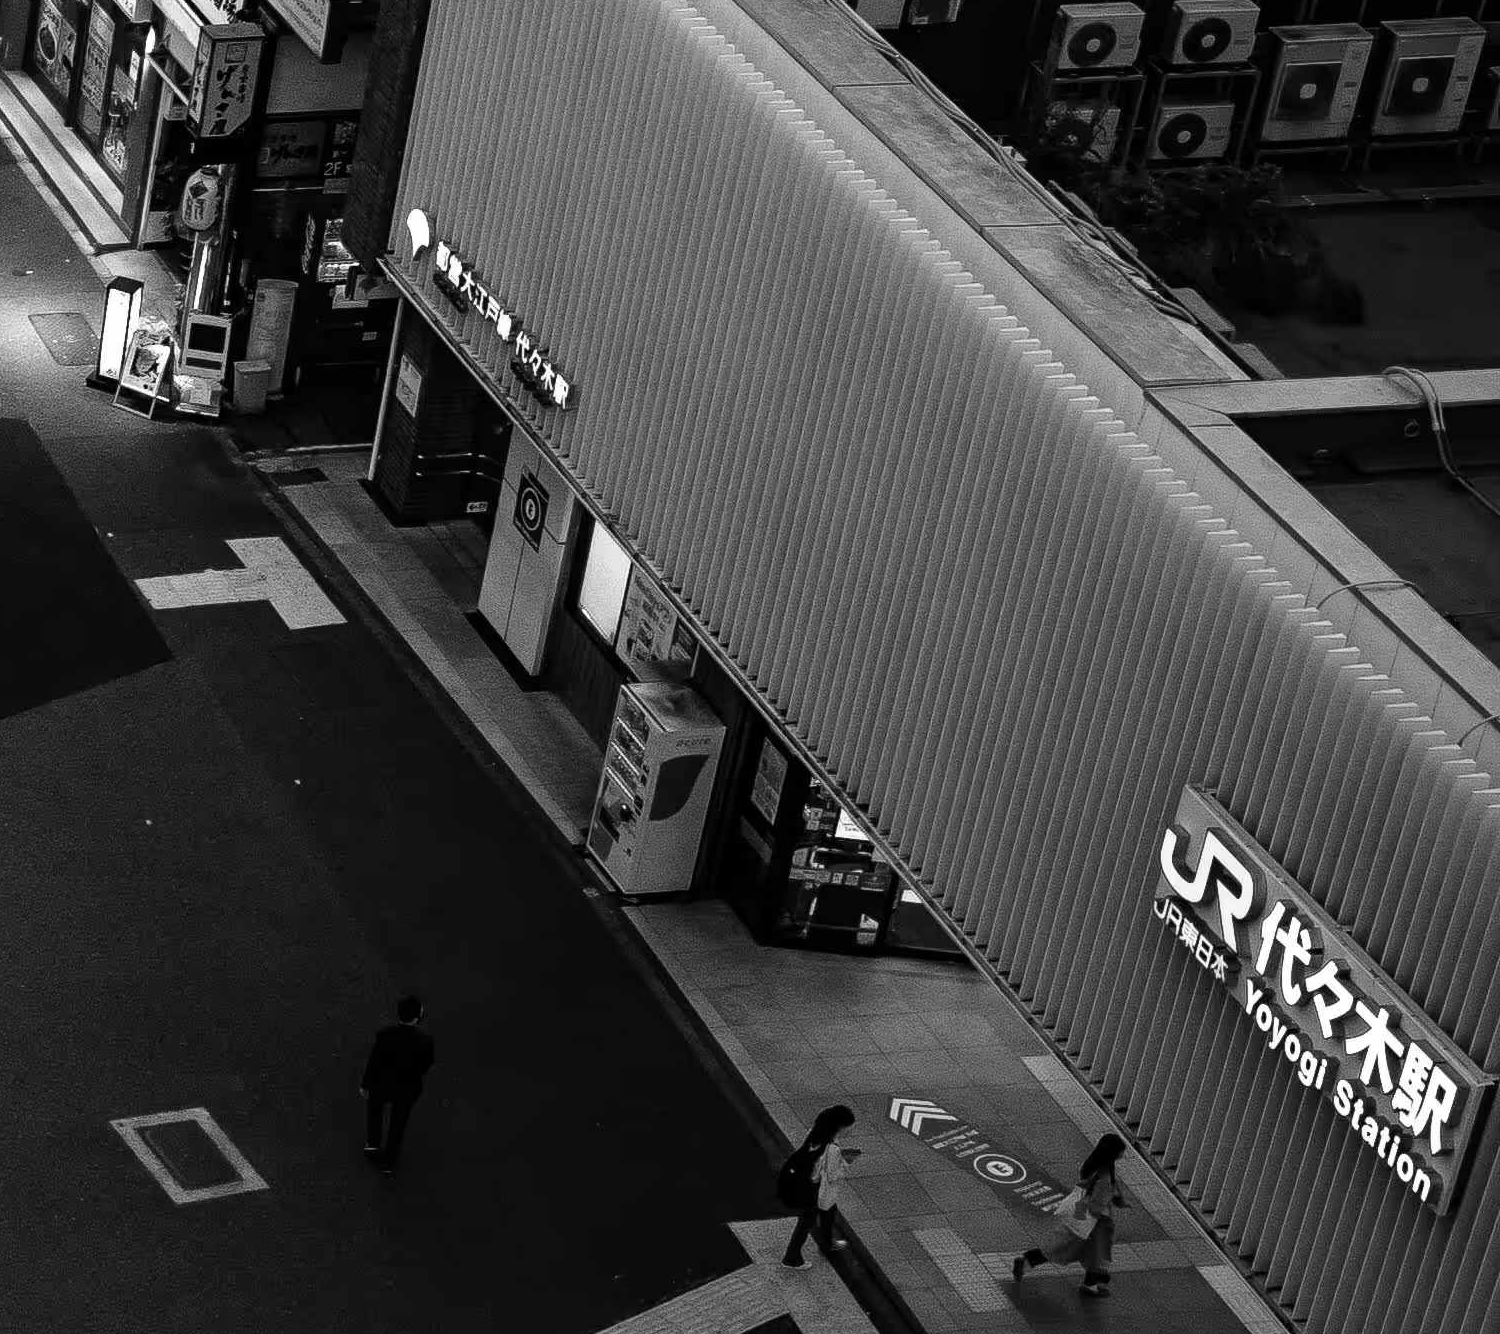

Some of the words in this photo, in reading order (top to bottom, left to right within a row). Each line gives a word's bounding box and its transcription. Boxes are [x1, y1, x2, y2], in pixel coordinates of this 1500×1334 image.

[1153, 898, 1229, 983] JR東日本
[1160, 827, 1254, 954] JR
[1246, 979, 1328, 1090] Yoyogi
[1333, 1078, 1432, 1202] Station
[1255, 900, 1458, 1155] 代々木駅
